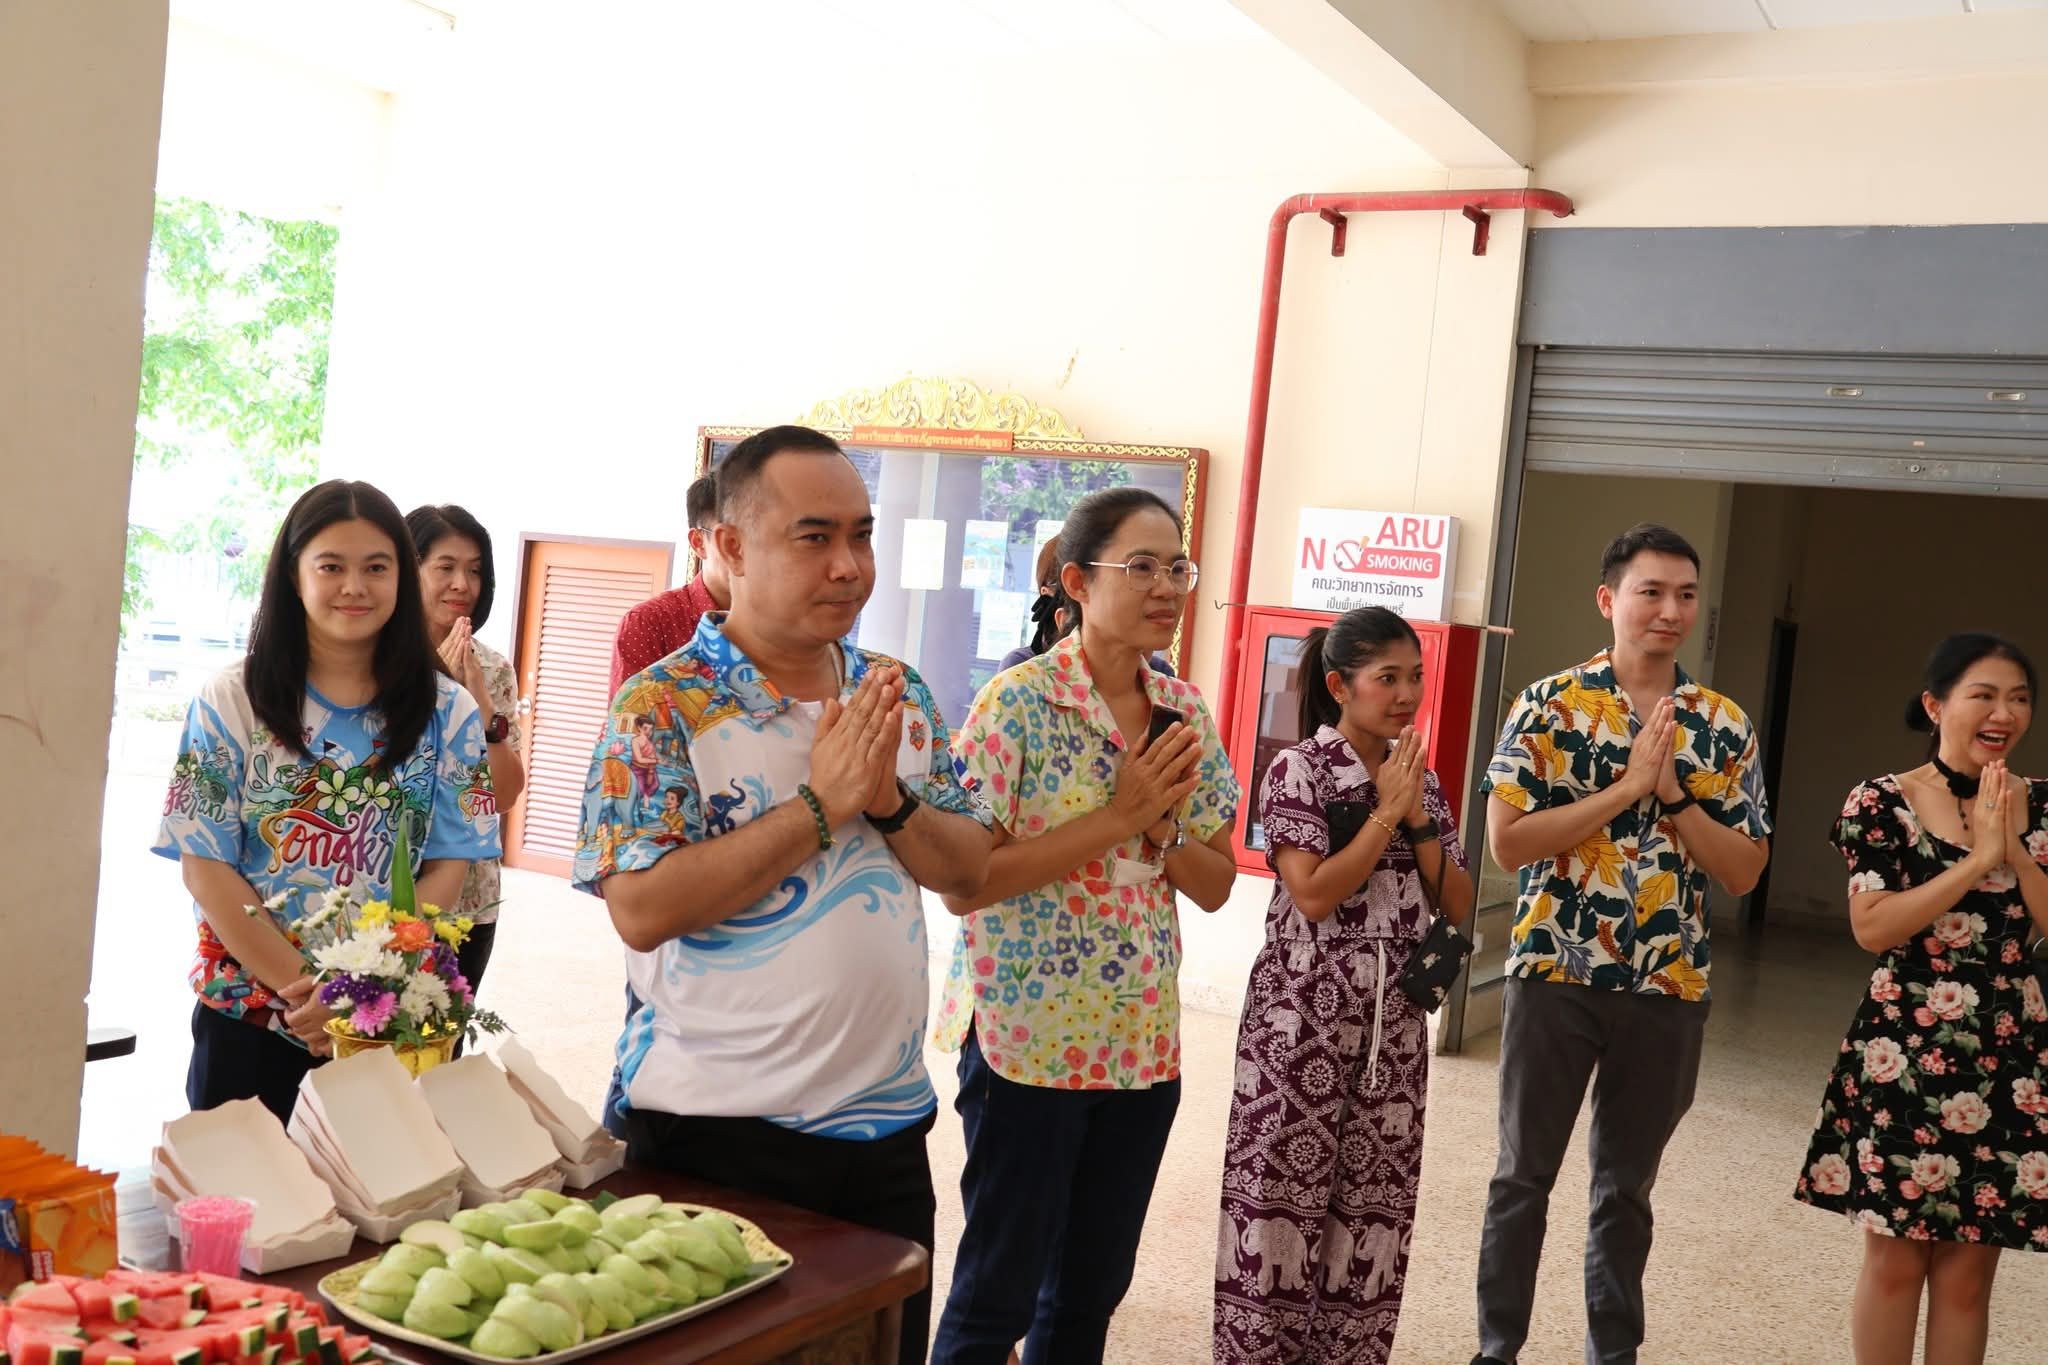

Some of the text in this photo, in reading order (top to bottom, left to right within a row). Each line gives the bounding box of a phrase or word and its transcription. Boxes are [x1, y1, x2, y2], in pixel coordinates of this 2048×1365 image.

[1376, 516, 1445, 549] ARU
[1366, 553, 1433, 573] SMOKING
[1312, 577, 1424, 598] คณะวิทยาการจัดการ
[259, 804, 421, 887] Songkr
